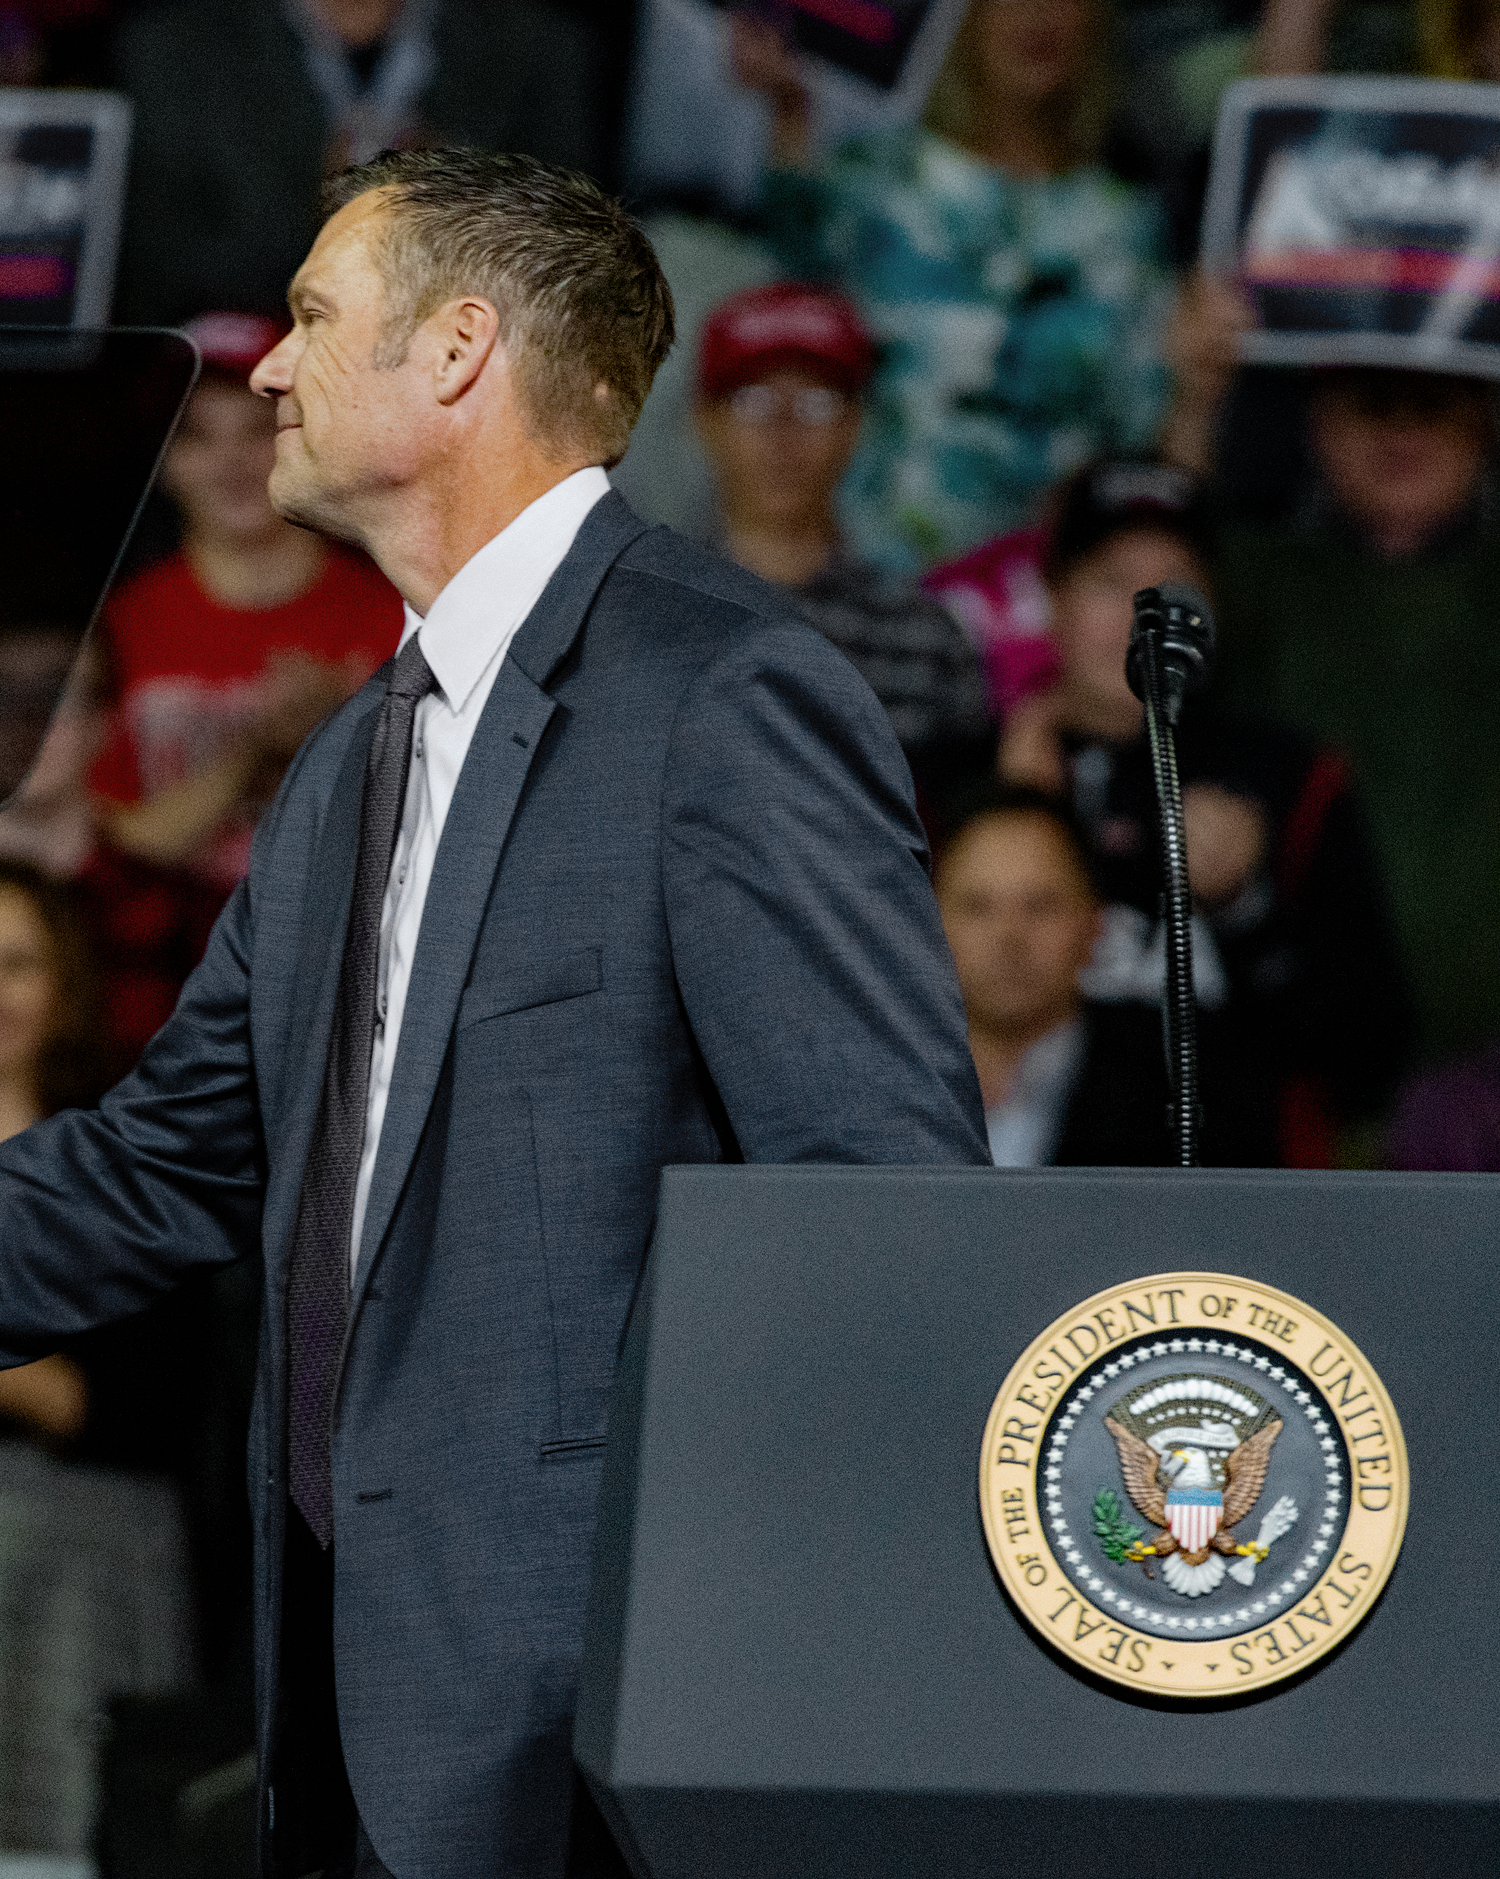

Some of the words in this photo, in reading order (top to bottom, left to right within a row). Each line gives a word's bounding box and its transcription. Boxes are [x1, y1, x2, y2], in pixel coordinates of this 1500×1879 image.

[1200, 1294, 1239, 1318] OF
[1247, 1303, 1299, 1344] THE
[998, 1289, 1185, 1468] PRESIDENT
[1308, 1343, 1392, 1513] UNITED
[1002, 1486, 1032, 1545] THE
[1017, 1552, 1047, 1587] OF
[1047, 1586, 1153, 1674] SEAL
[1231, 1551, 1373, 1676] STATES
